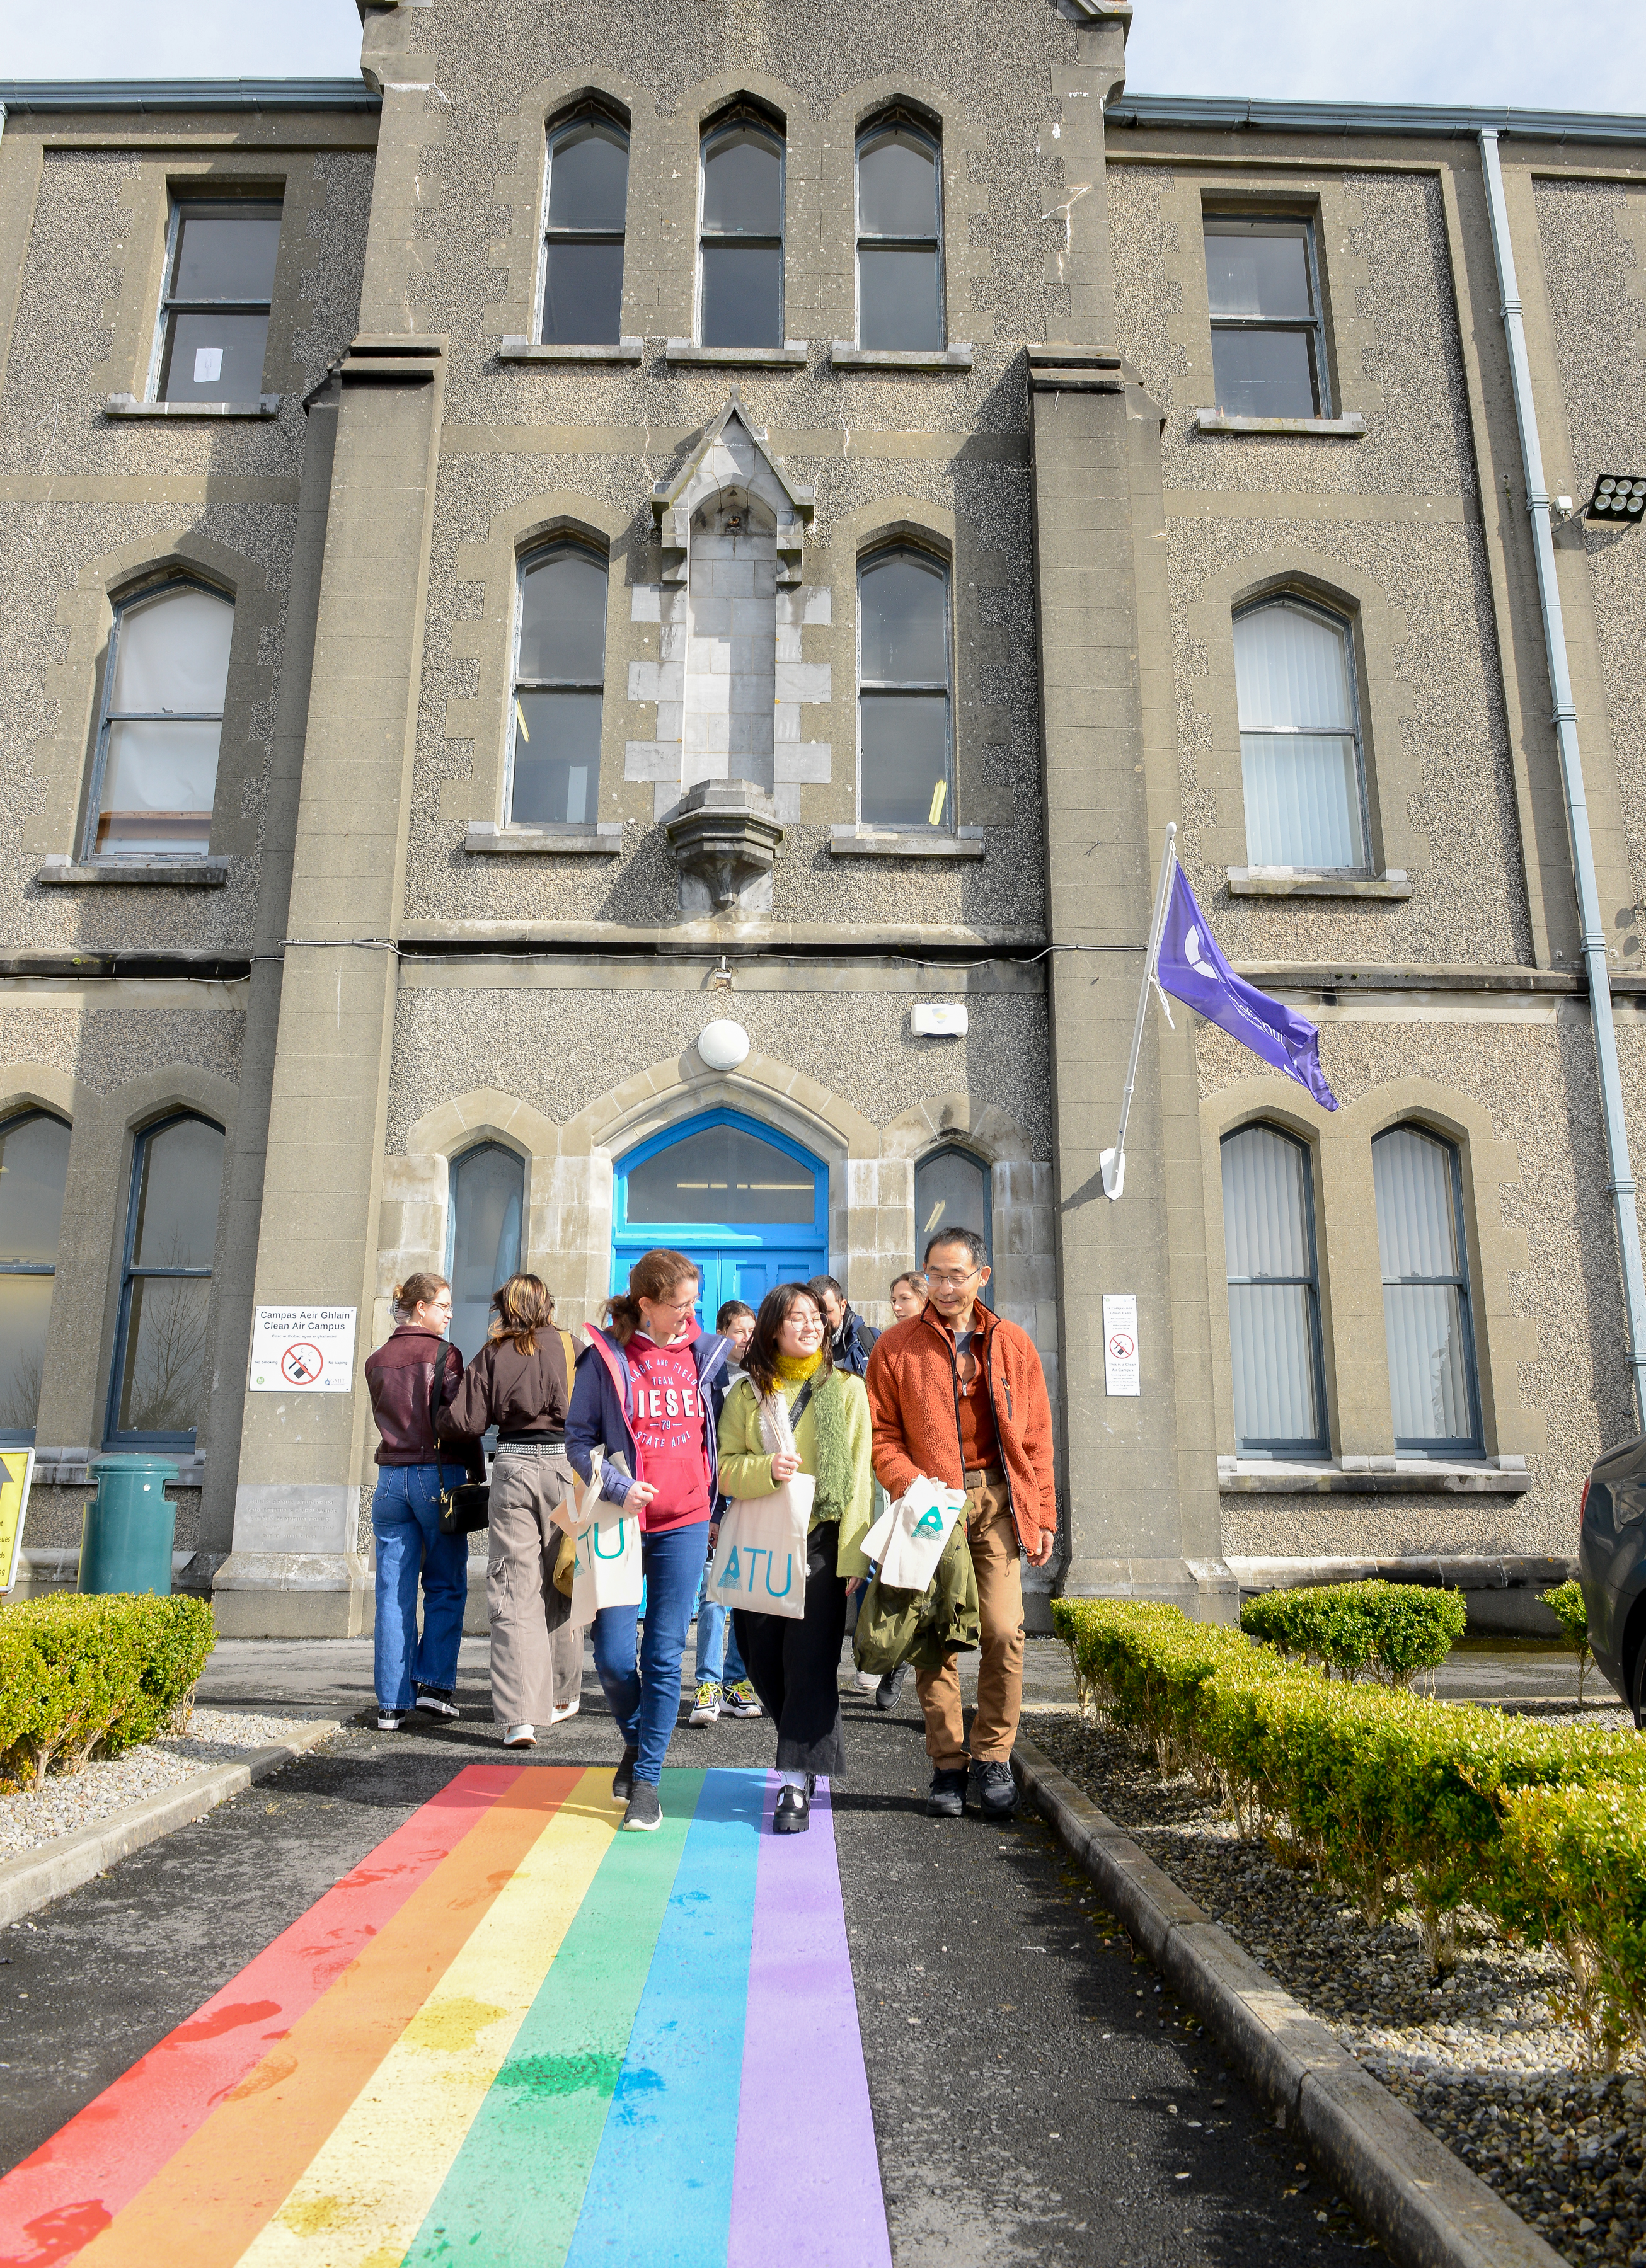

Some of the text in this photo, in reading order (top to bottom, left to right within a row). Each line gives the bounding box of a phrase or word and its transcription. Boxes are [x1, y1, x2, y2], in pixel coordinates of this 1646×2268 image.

[260, 1311, 297, 1320] Campas
[308, 1322, 345, 1331] Campus
[630, 1360, 653, 1383] RACK
[672, 1362, 698, 1386] FIELD
[652, 1376, 674, 1386] TEAM
[638, 1389, 705, 1418] IESEL
[661, 1420, 671, 1430] 79
[635, 1431, 665, 1448] STATE
[717, 1545, 793, 1598] ATU
